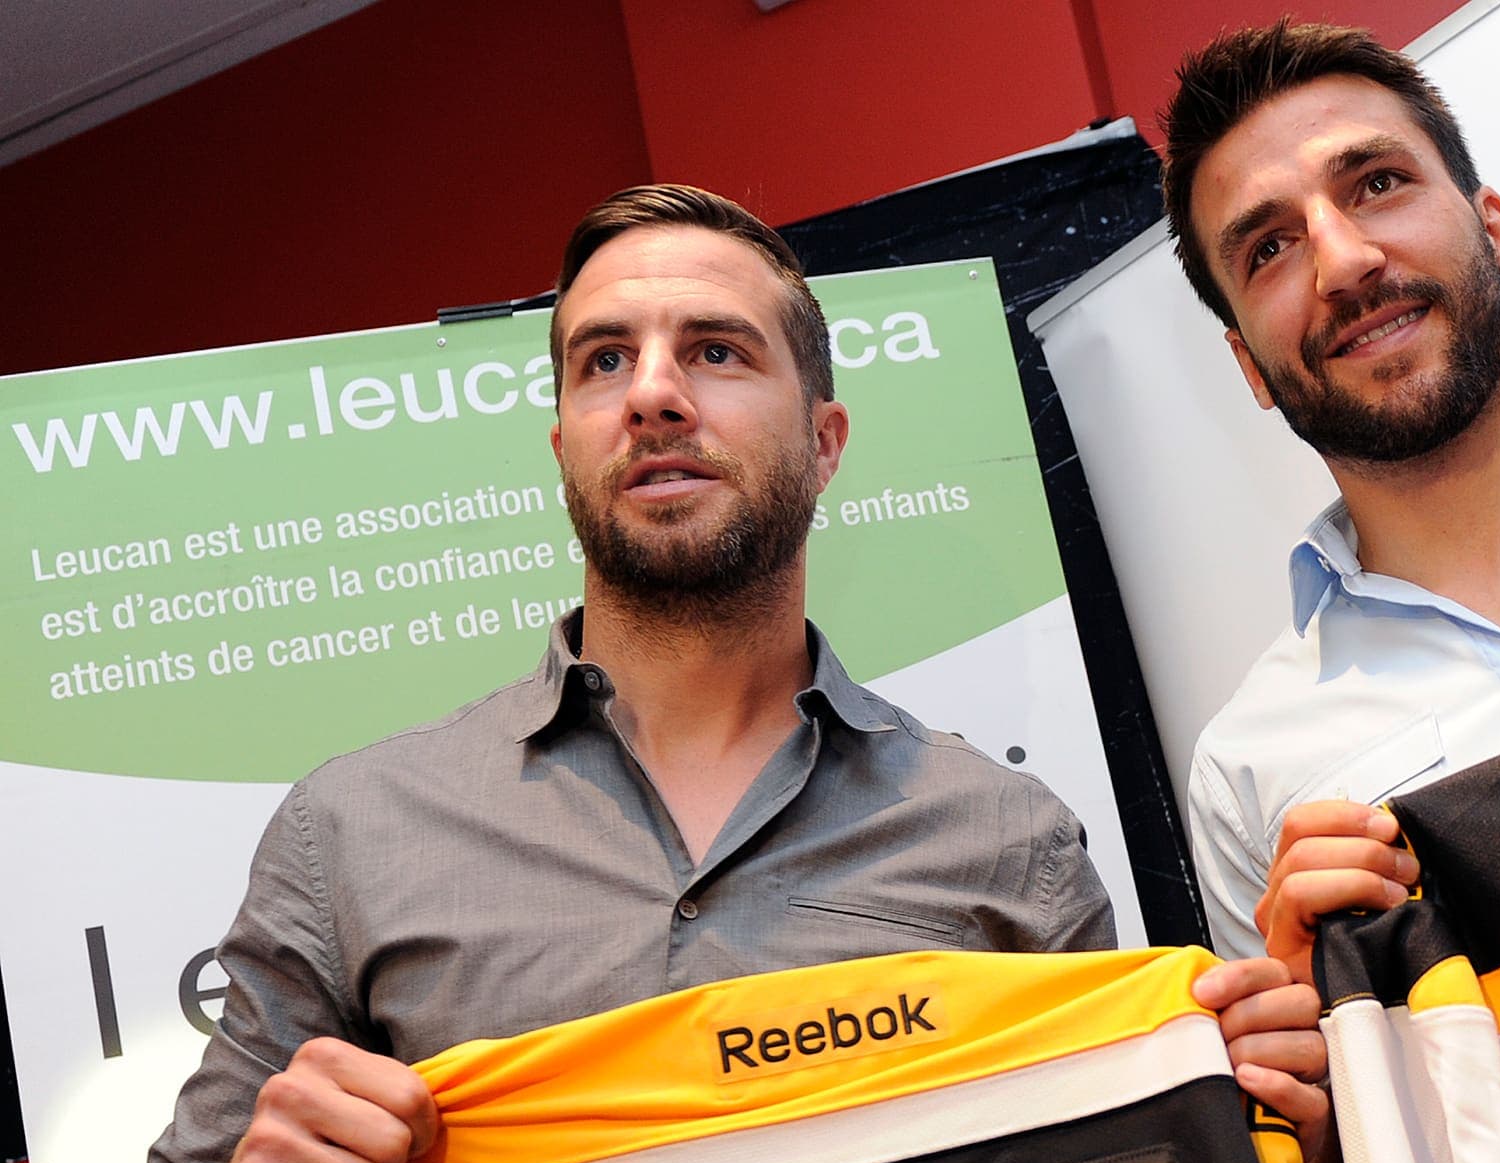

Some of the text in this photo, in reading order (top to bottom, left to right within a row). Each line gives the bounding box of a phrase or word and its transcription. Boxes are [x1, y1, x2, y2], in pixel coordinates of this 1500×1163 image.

[31, 536, 172, 582] Leucan
[184, 522, 244, 560] est
[253, 515, 324, 551] une
[335, 485, 545, 539] association
[840, 482, 970, 526] enfants
[41, 601, 101, 640] est
[328, 565, 364, 599] la
[375, 540, 555, 592] confiance
[50, 650, 196, 700] atteints
[208, 641, 254, 676] de
[266, 623, 394, 667] cancer
[408, 610, 446, 647] et
[455, 604, 500, 640] de
[717, 993, 936, 1073] Reebok
